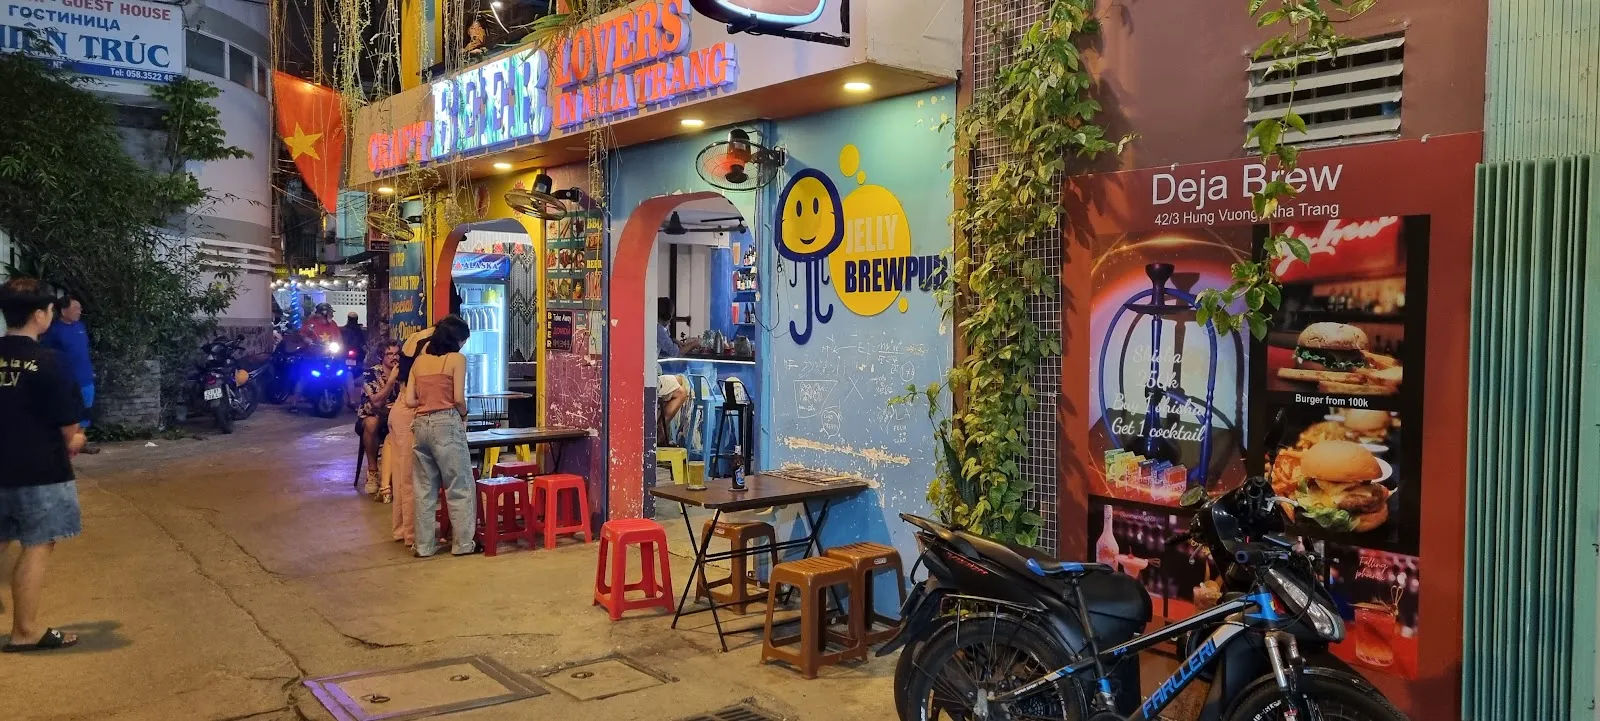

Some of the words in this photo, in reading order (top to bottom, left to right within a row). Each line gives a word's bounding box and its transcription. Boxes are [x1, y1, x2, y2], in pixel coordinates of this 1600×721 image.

[8, 5, 120, 31] ГОСТИНИЦА
[120, 4, 171, 21] HOUSE
[78, 34, 170, 68] TRÚC
[554, 0, 688, 87] LOVERS
[111, 68, 124, 76] Tel:
[126, 69, 161, 81] 058.3522
[554, 91, 582, 127] IN
[635, 42, 735, 104] TRANG
[430, 48, 550, 158] BEER
[1152, 169, 1228, 210] Deja
[1243, 164, 1343, 198] Brew
[1155, 213, 1180, 226] 42/3
[1183, 211, 1215, 226] Hung
[1299, 203, 1339, 218] Trang
[845, 214, 898, 254] JELLY
[464, 261, 499, 270] ALASKA
[845, 255, 948, 292] BREWPUB
[1295, 393, 1323, 405] Burger
[1325, 395, 1346, 405] from
[1348, 397, 1369, 407] 100k
[1112, 416, 1136, 436] Get
[1137, 419, 1146, 437] 1
[1149, 421, 1207, 442] cocktail
